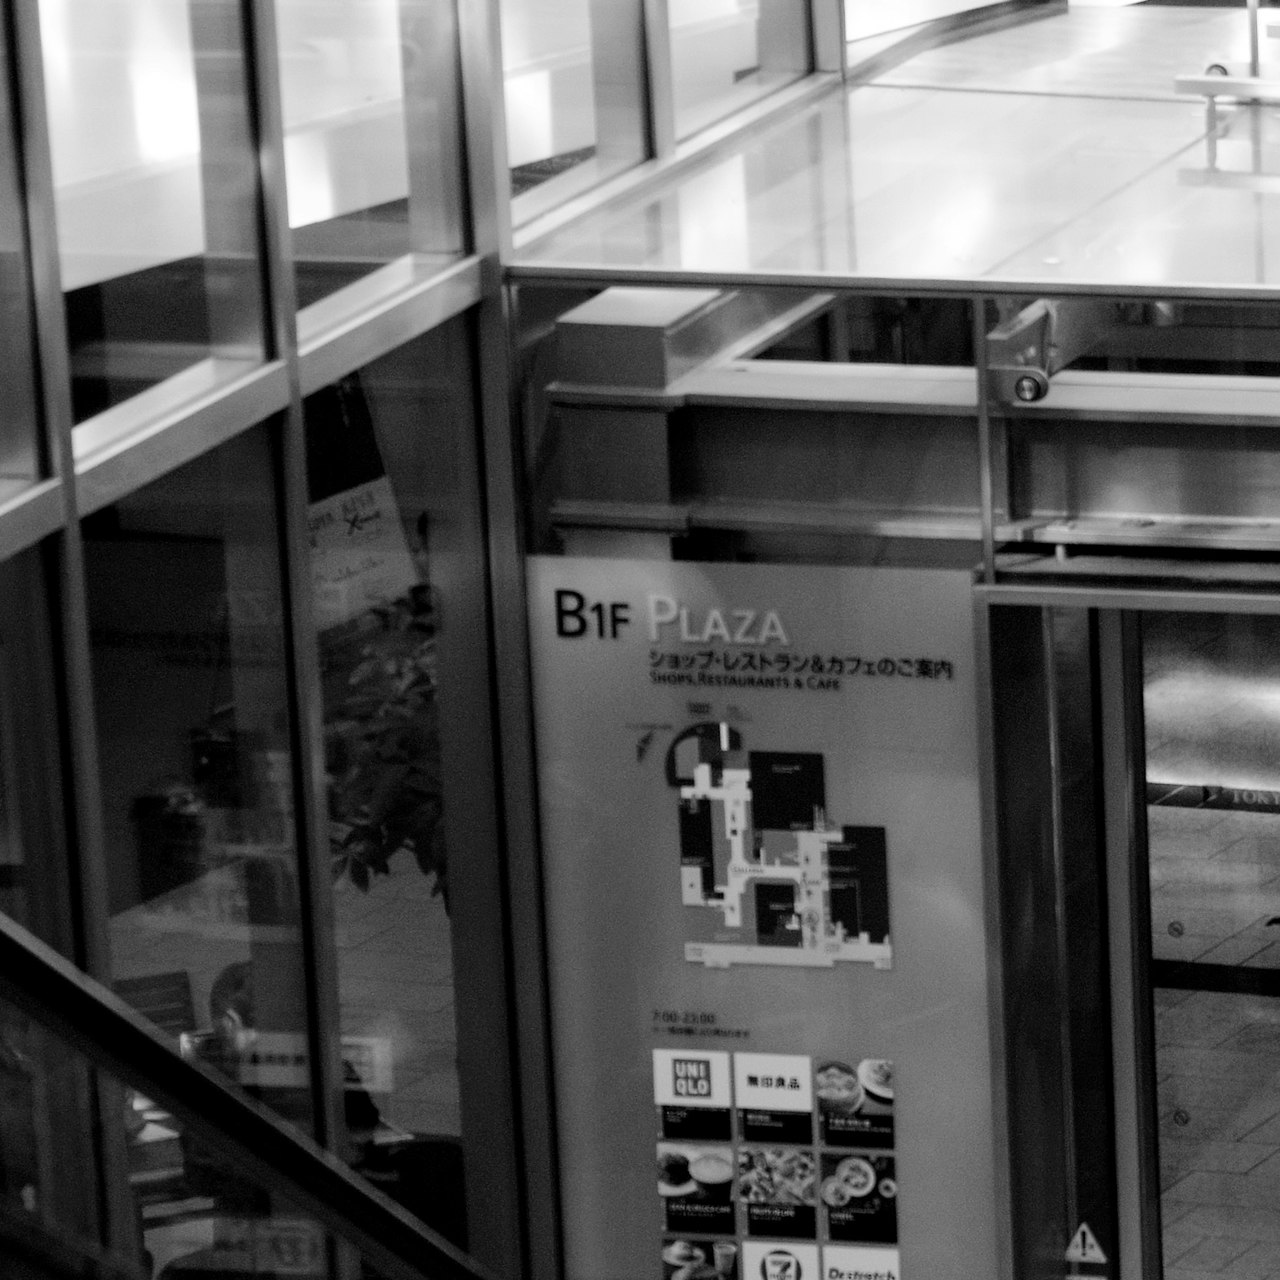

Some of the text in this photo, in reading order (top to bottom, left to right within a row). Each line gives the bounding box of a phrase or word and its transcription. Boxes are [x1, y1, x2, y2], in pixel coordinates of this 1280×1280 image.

[555, 589, 789, 645] B1F PLAZA
[698, 671, 790, 689] RESTAURANTS
[675, 1061, 706, 1078] UNI
[676, 1078, 709, 1096] QLO
